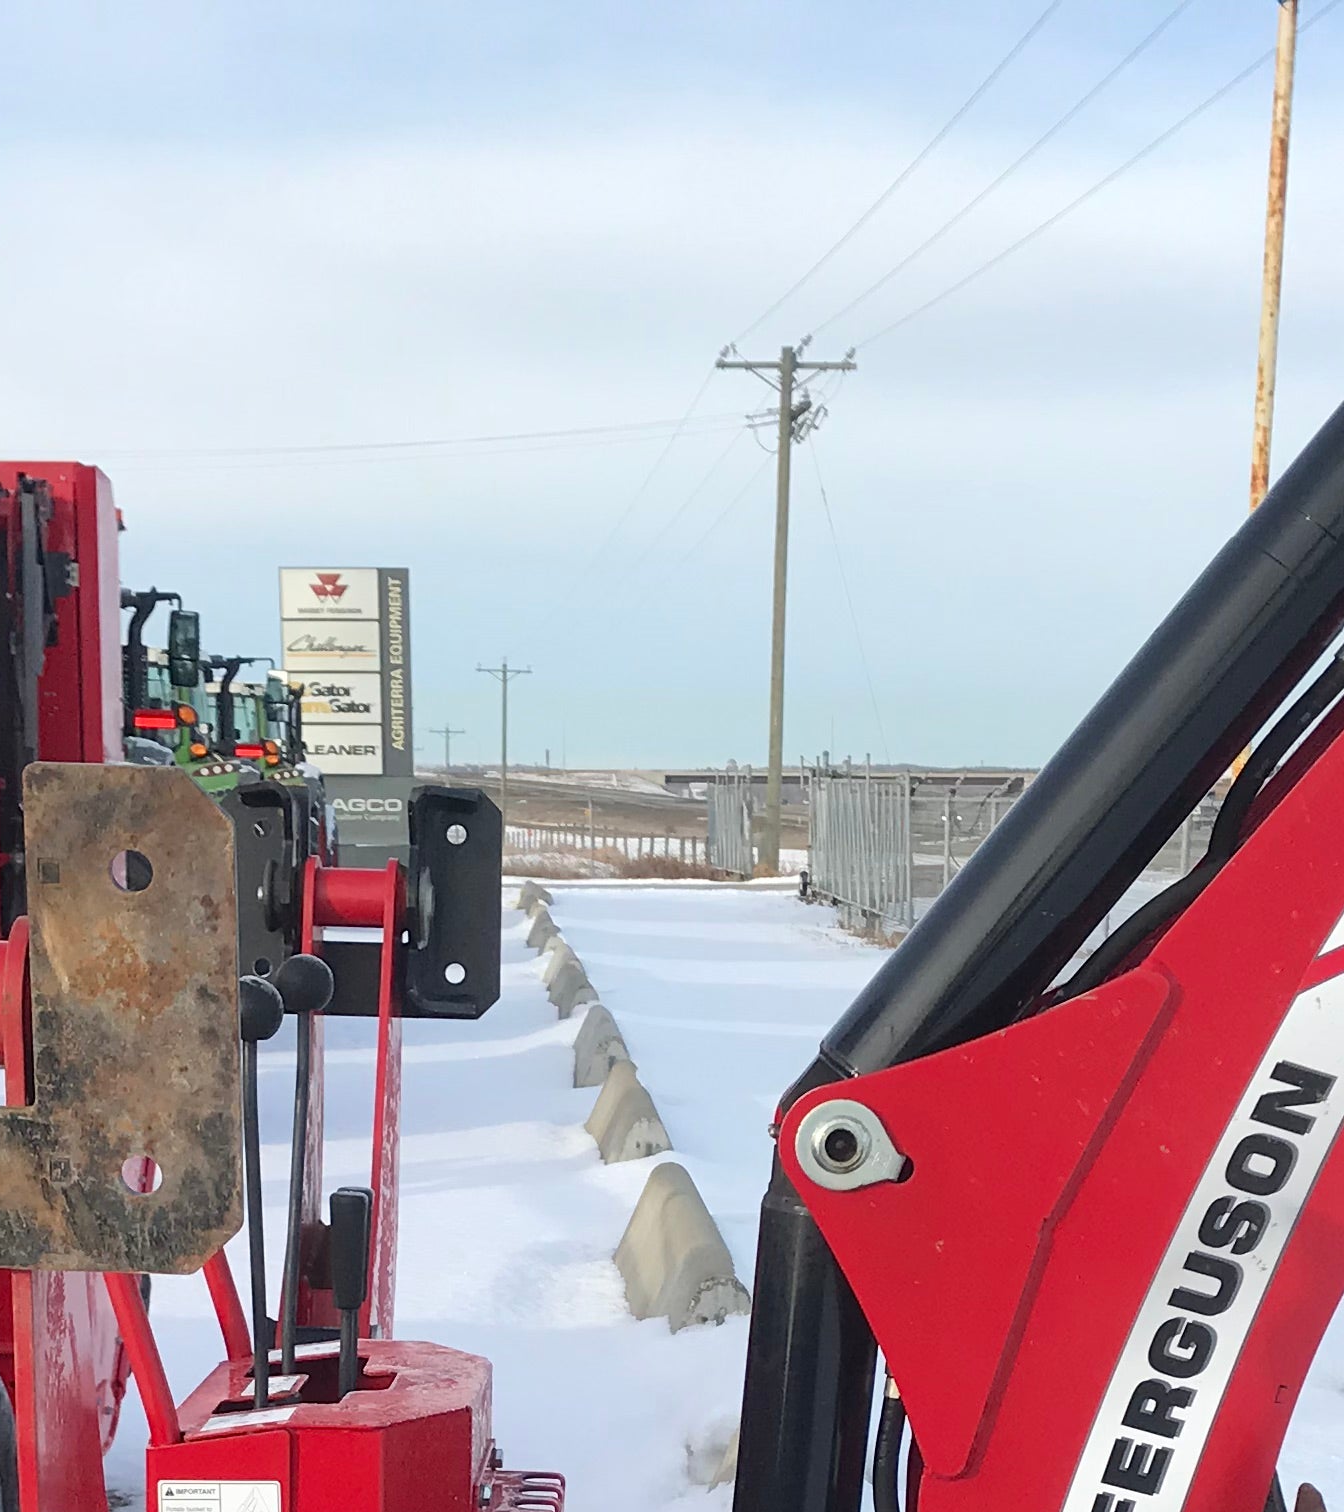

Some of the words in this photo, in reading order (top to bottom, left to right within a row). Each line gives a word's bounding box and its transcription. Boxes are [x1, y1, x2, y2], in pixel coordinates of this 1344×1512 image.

[388, 576, 403, 665] EQUIPMENT
[286, 634, 367, 658] Challenger
[390, 669, 404, 751] AGRITERRA
[306, 744, 377, 756] LEANER
[332, 798, 403, 812] AGCO
